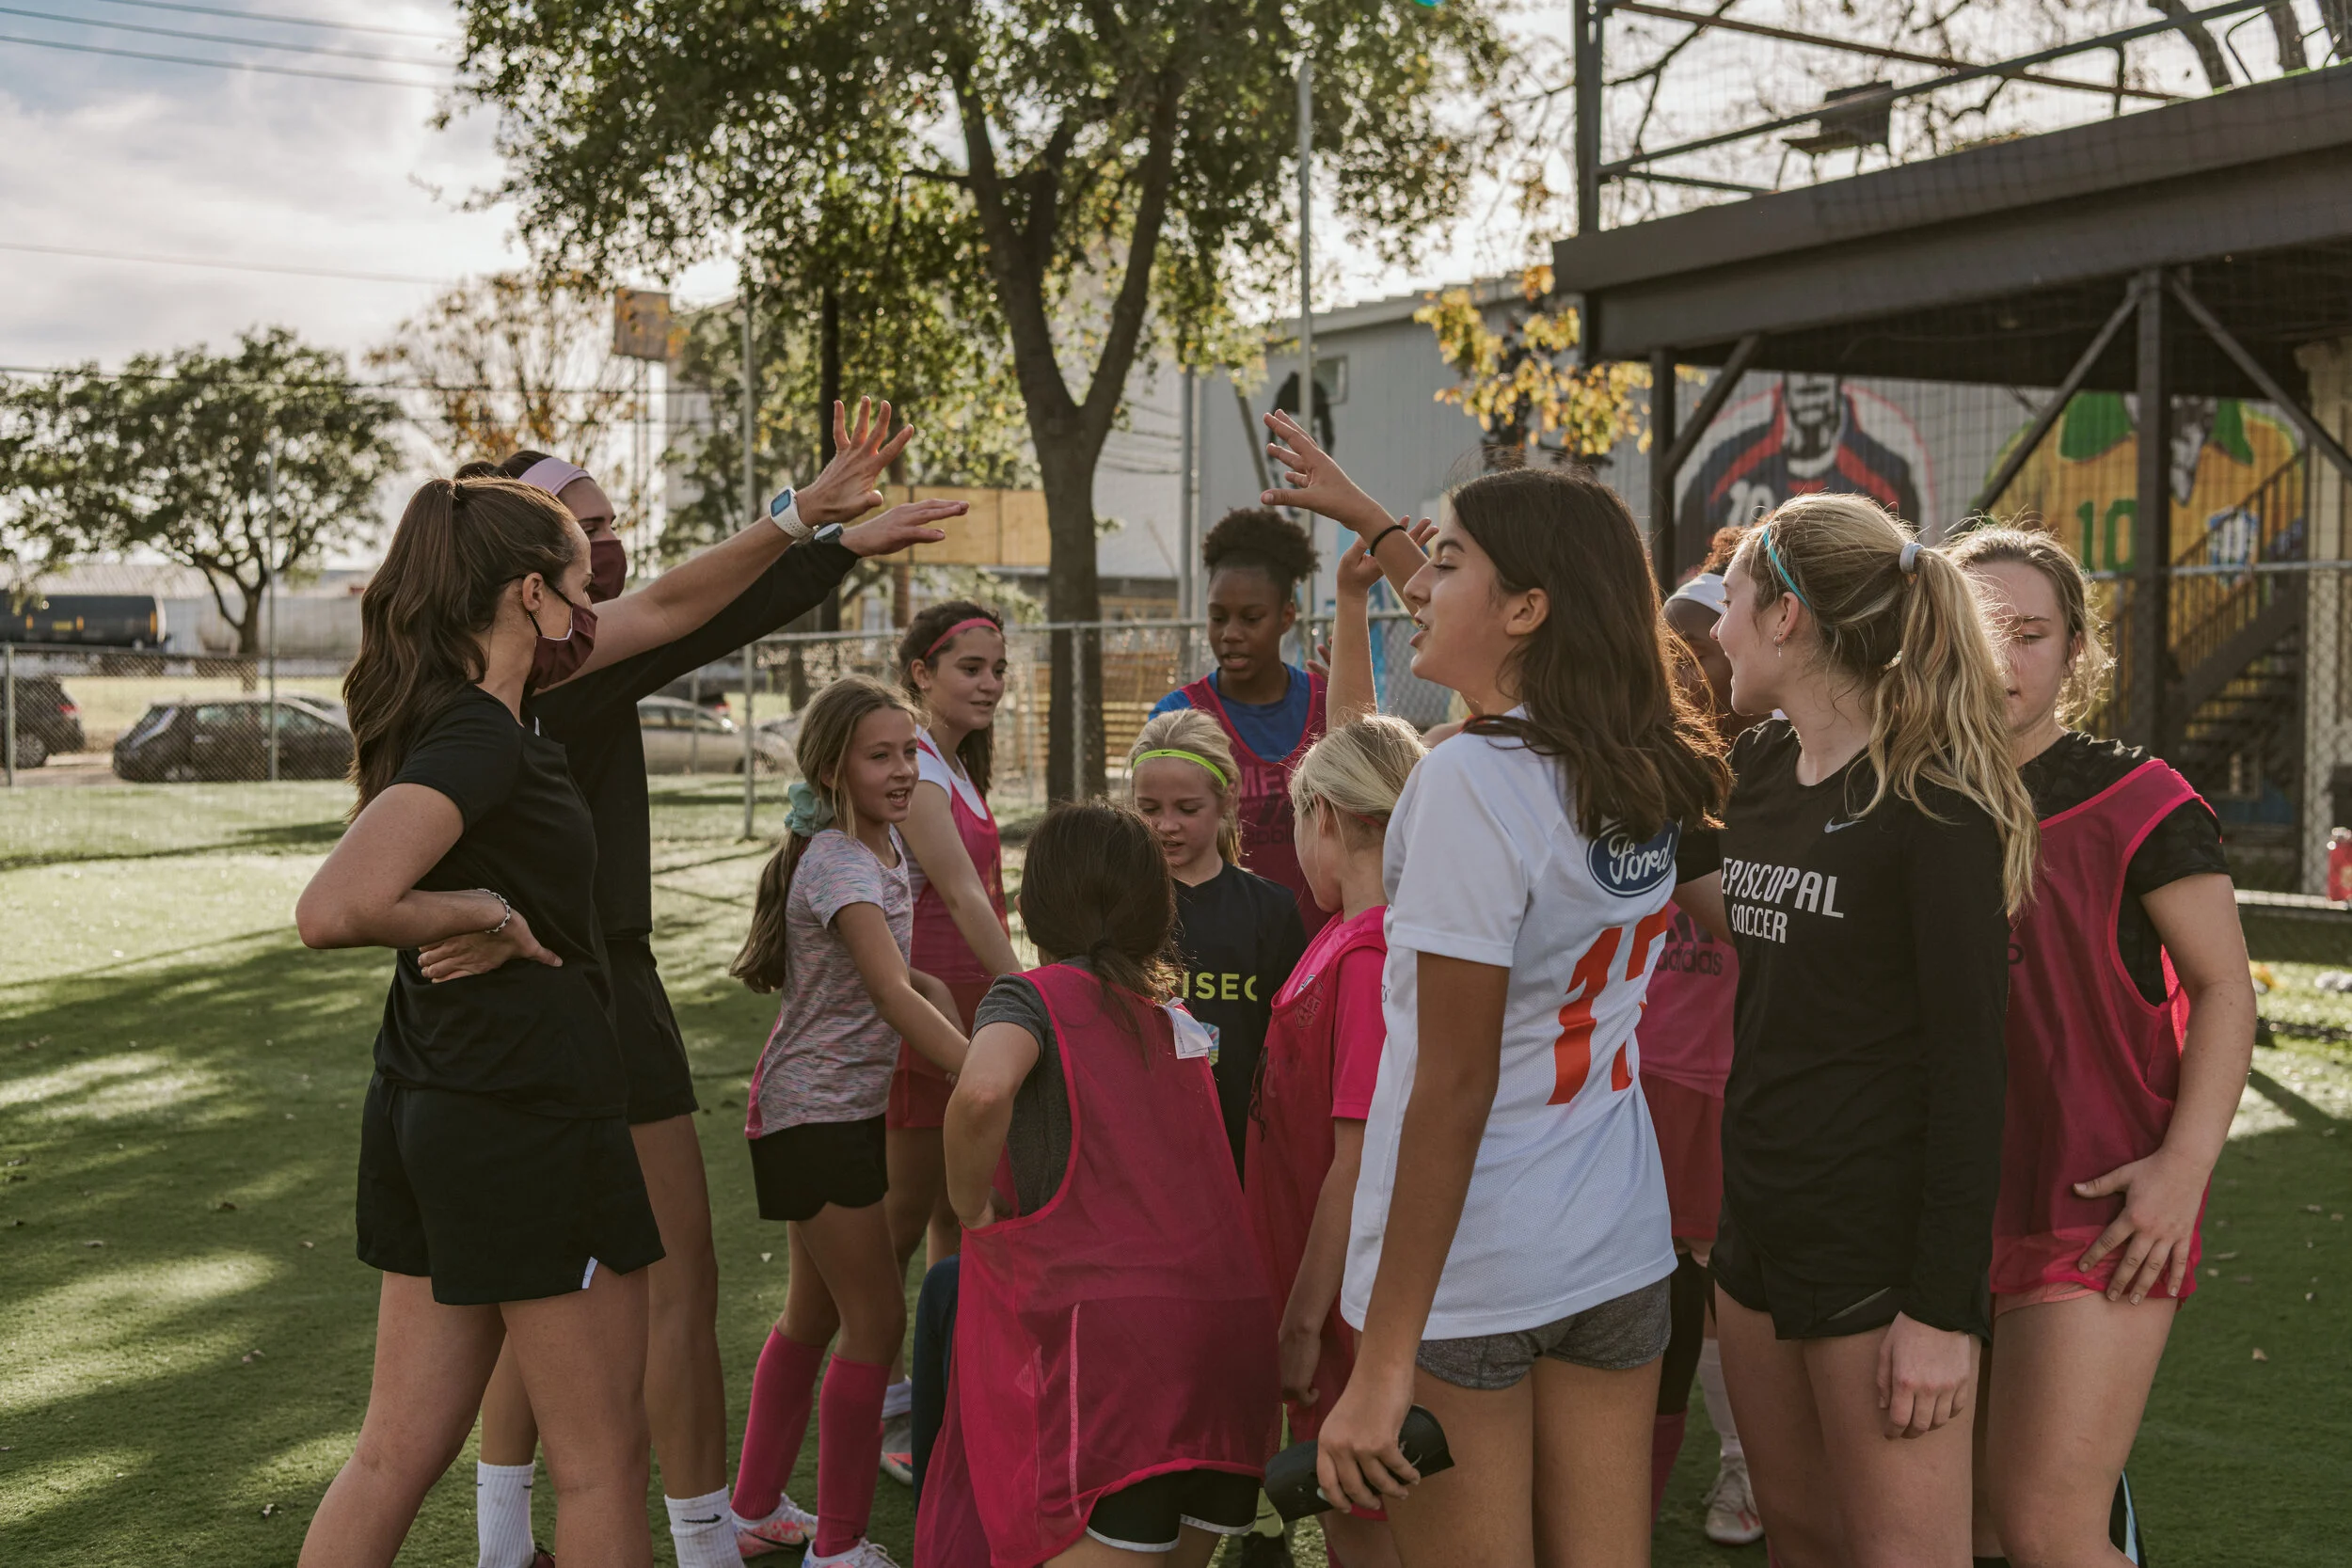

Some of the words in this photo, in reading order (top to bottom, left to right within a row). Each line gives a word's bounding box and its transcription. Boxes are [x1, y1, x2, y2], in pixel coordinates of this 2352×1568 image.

[2075, 500, 2138, 572] 10
[1608, 832, 1673, 885] Ford
[1721, 857, 1845, 919] EPISCOPAL
[1731, 903, 1788, 943] SOCCER
